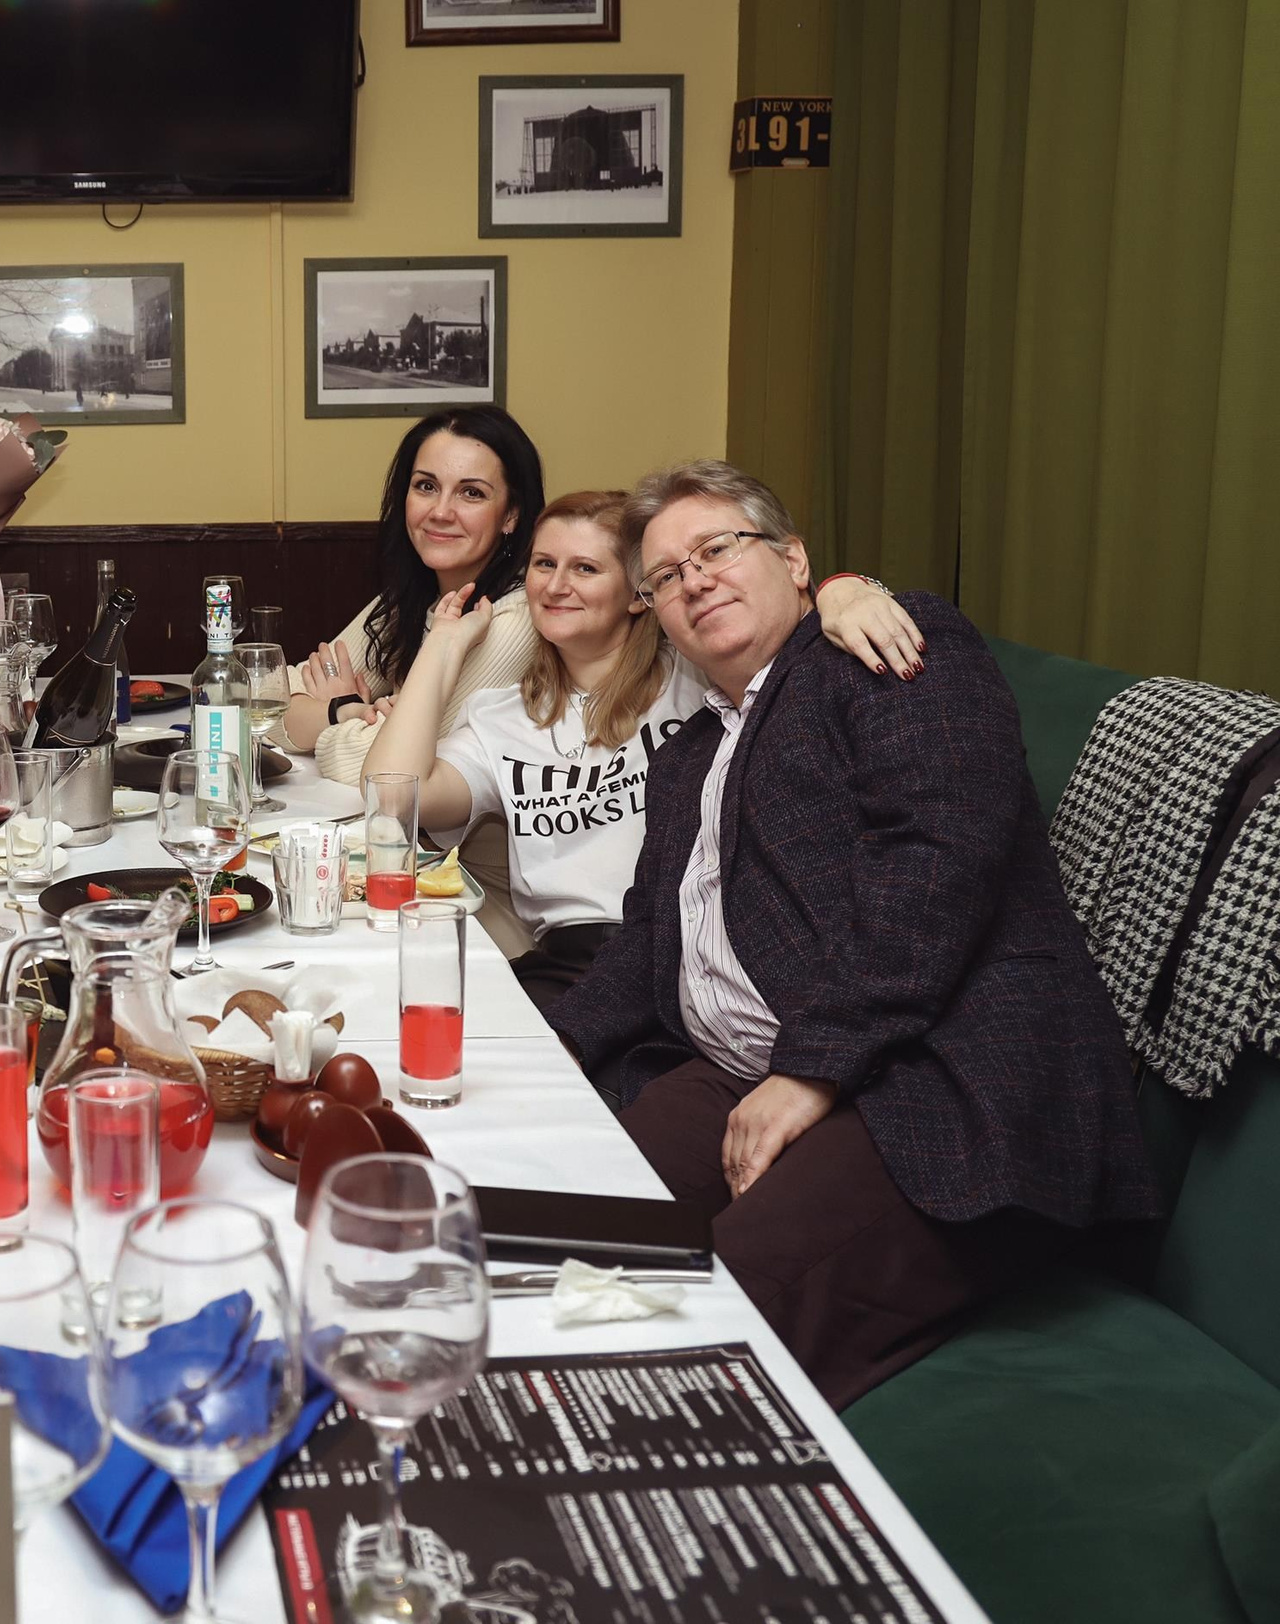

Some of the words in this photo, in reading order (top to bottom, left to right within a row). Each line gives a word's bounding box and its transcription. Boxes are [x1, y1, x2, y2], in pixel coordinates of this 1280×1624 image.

[762, 101, 793, 112] NEW
[74, 181, 106, 189] SAMSUNG
[502, 746, 627, 796] THIS
[510, 794, 571, 811] WHAT
[577, 792, 591, 803] A
[514, 797, 624, 837] LOOKS
